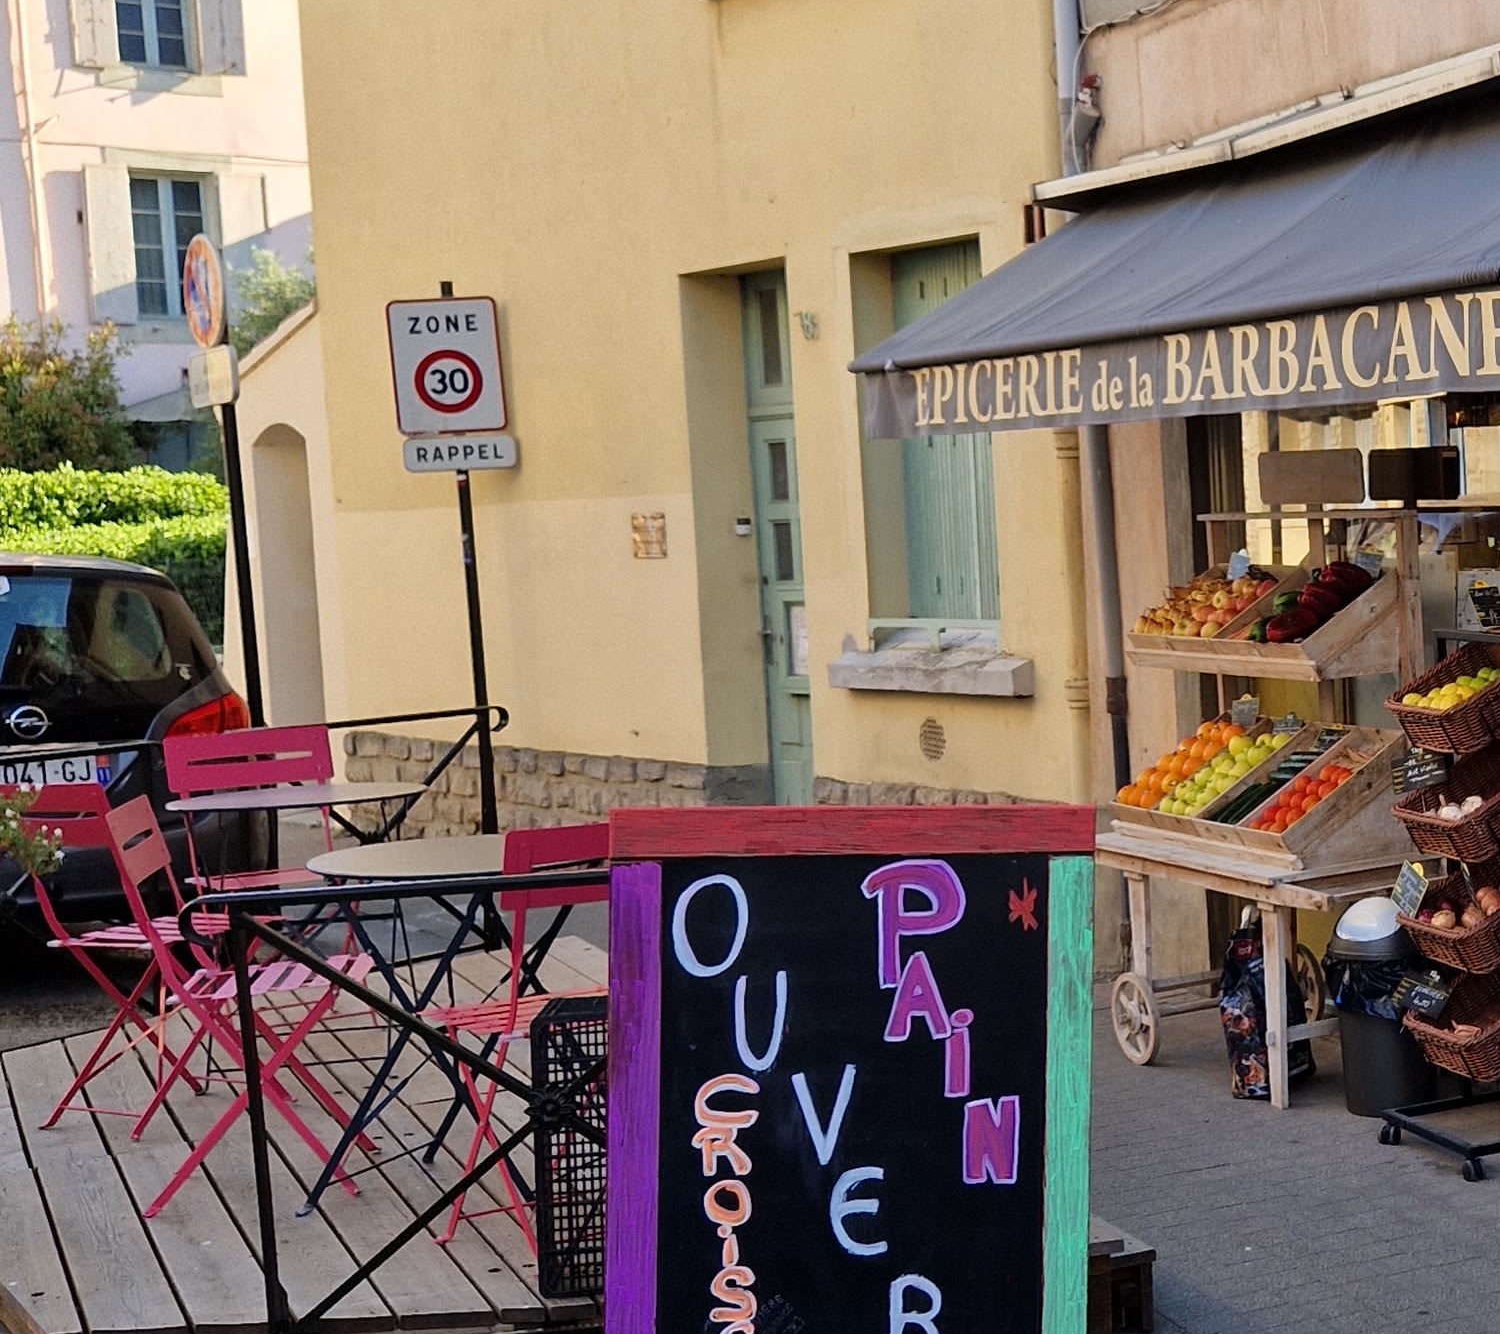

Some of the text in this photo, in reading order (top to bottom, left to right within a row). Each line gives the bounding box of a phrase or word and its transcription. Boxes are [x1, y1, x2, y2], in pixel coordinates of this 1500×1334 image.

[407, 314, 479, 335] ZONE
[430, 368, 470, 395] 30
[912, 348, 1083, 427] EPICERIE
[1091, 360, 1127, 413] de
[1128, 355, 1154, 409] la
[416, 443, 504, 463] RAPPEL
